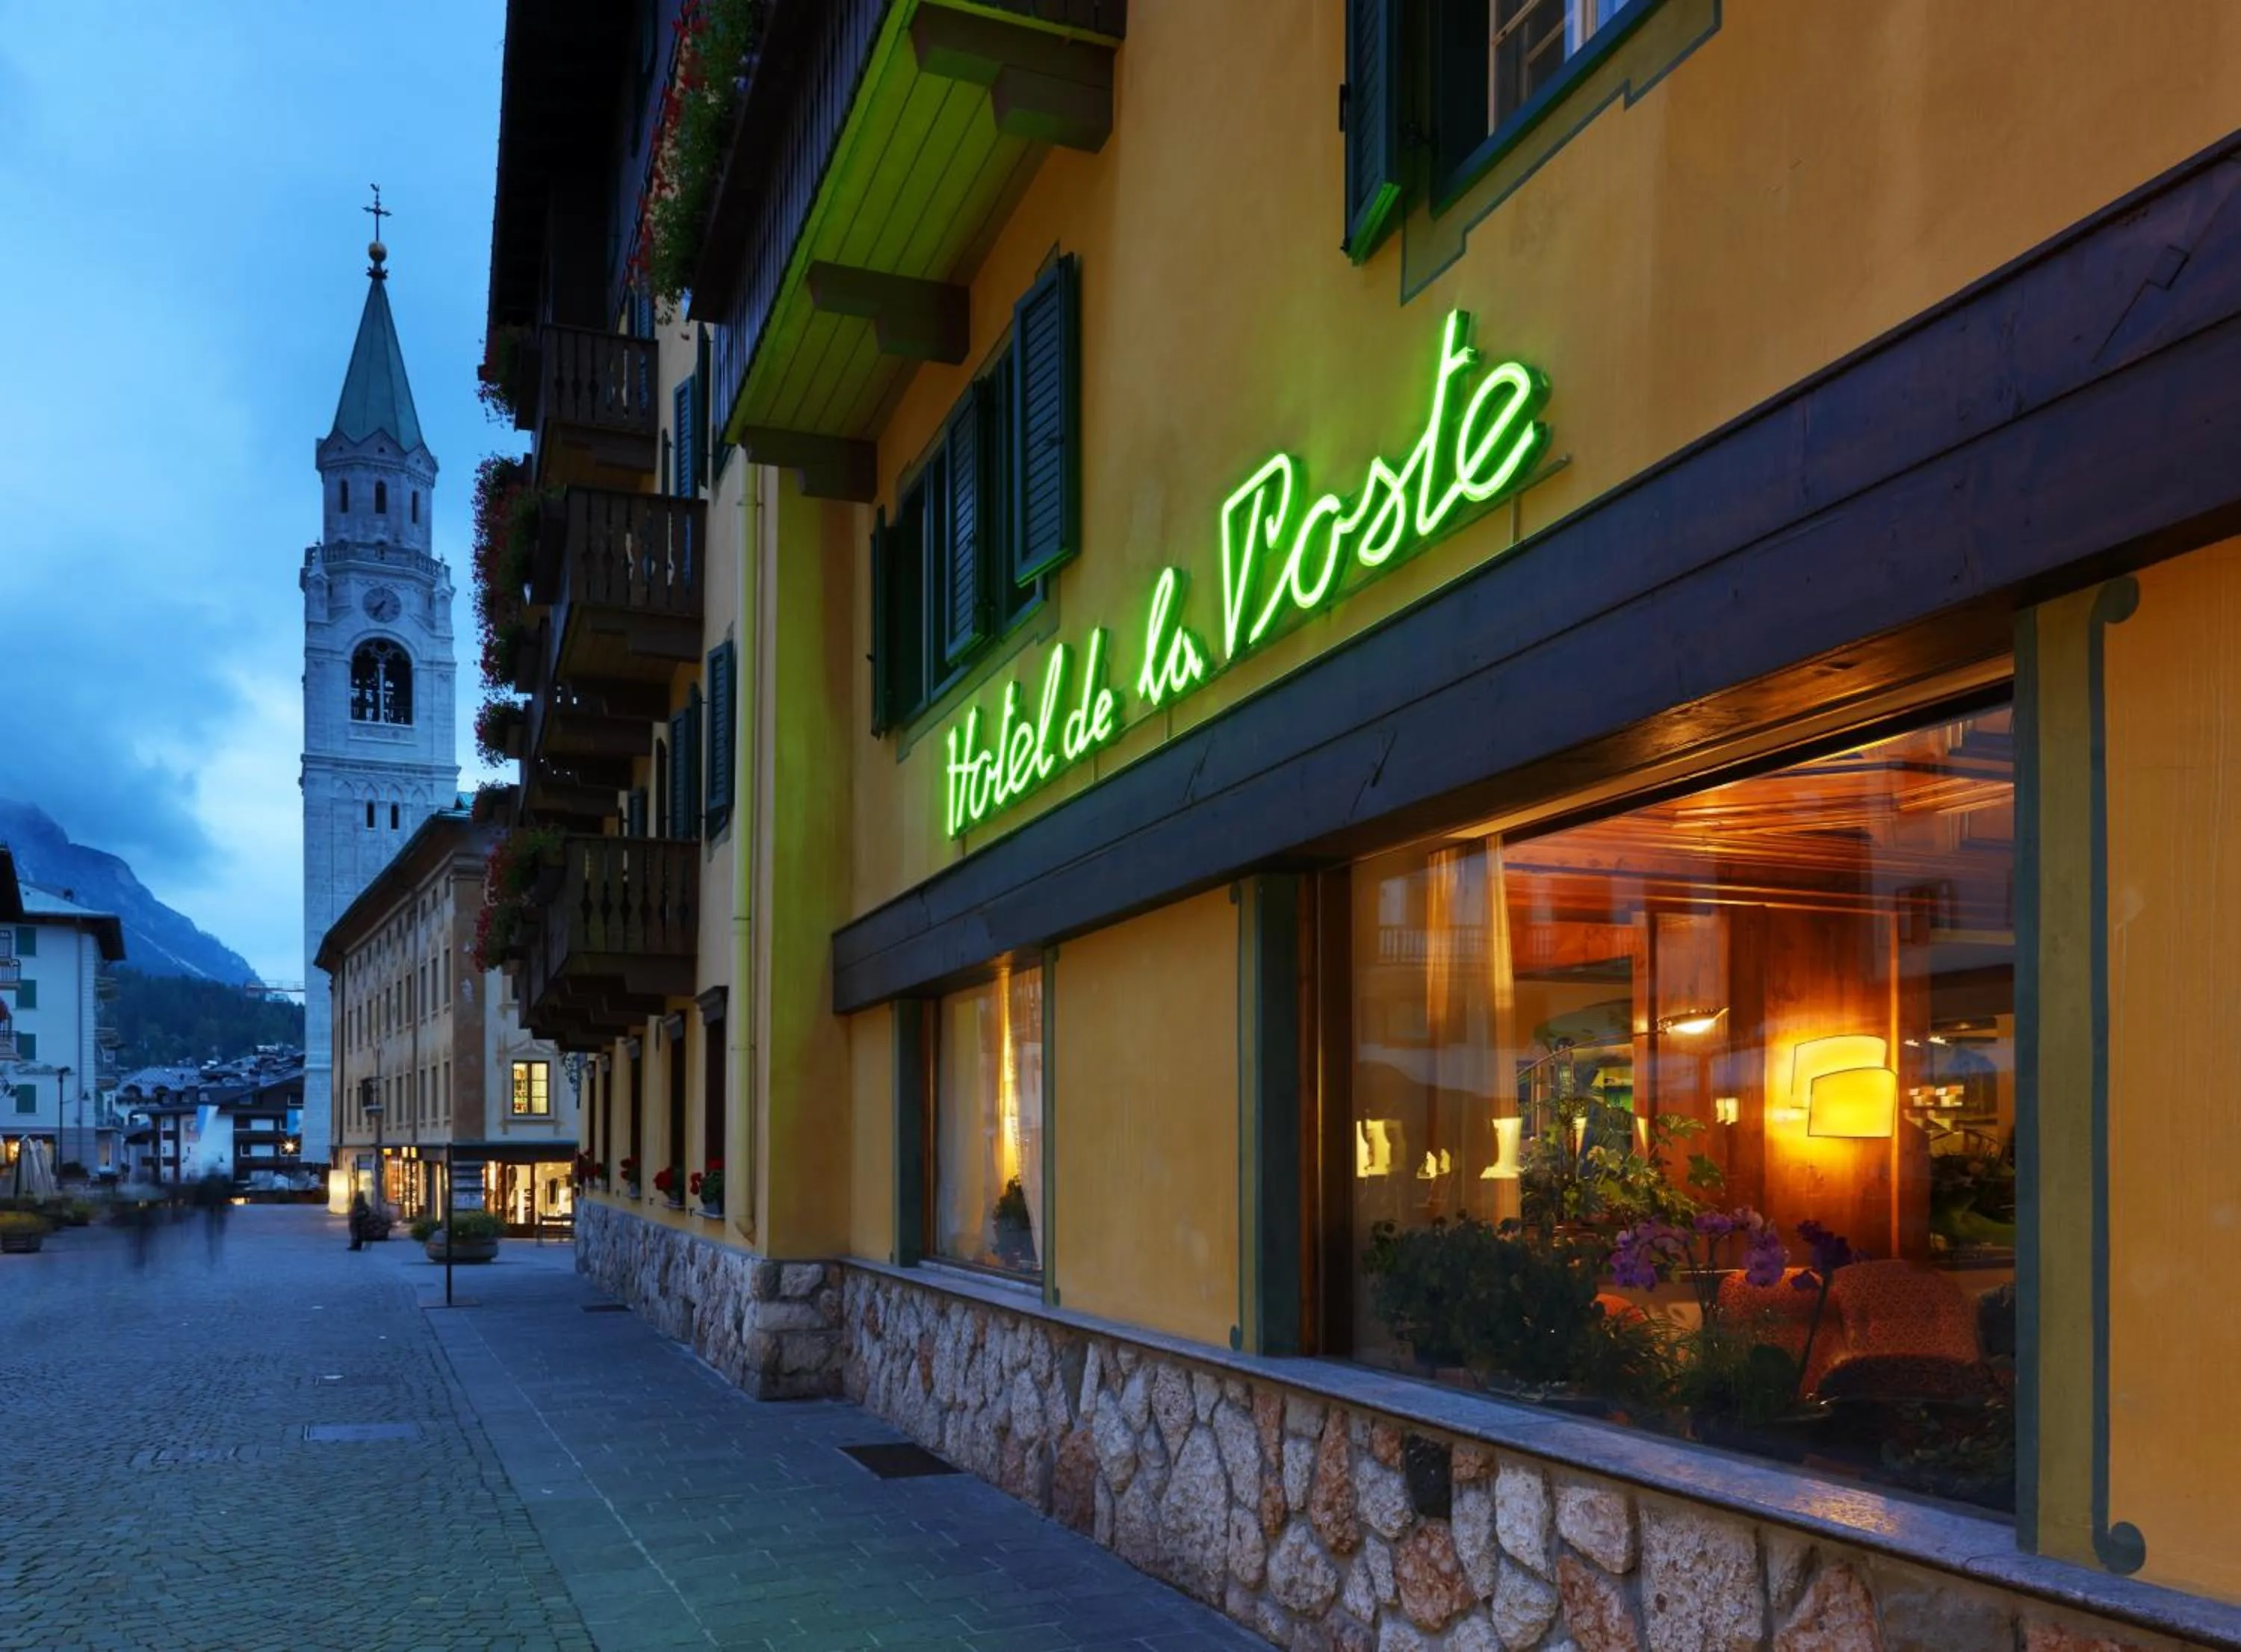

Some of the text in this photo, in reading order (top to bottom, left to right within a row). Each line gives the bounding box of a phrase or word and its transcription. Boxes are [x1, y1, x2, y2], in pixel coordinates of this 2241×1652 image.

[944, 308, 1546, 837] Hotel de la Poste
